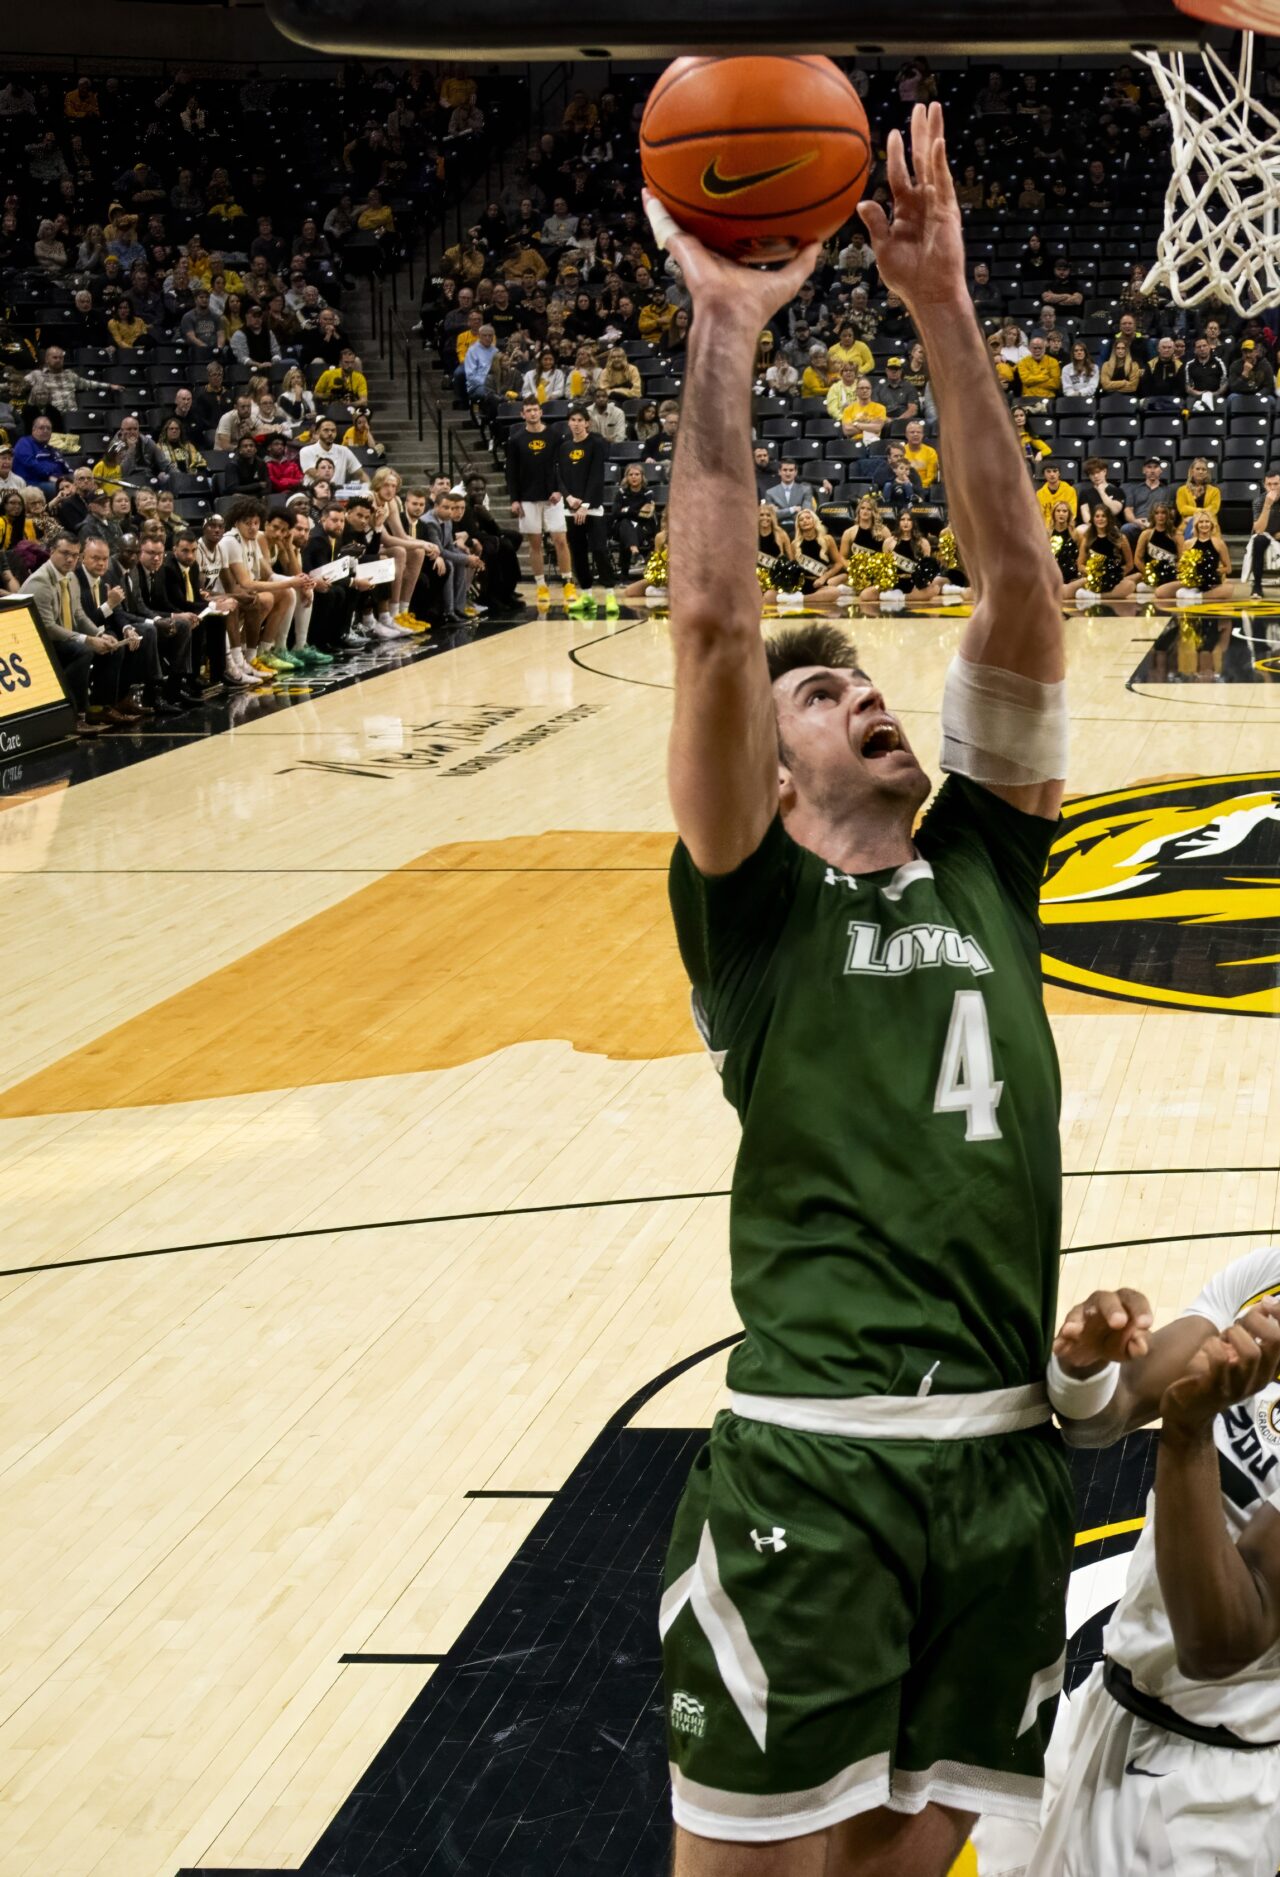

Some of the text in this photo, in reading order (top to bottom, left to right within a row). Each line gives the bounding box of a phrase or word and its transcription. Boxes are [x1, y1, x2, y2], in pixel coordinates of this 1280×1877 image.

[0, 652, 31, 692] es
[0, 731, 22, 753] Care
[485, 725, 570, 754] STEWART
[843, 920, 995, 977] LOYO
[933, 990, 1004, 1142] 4
